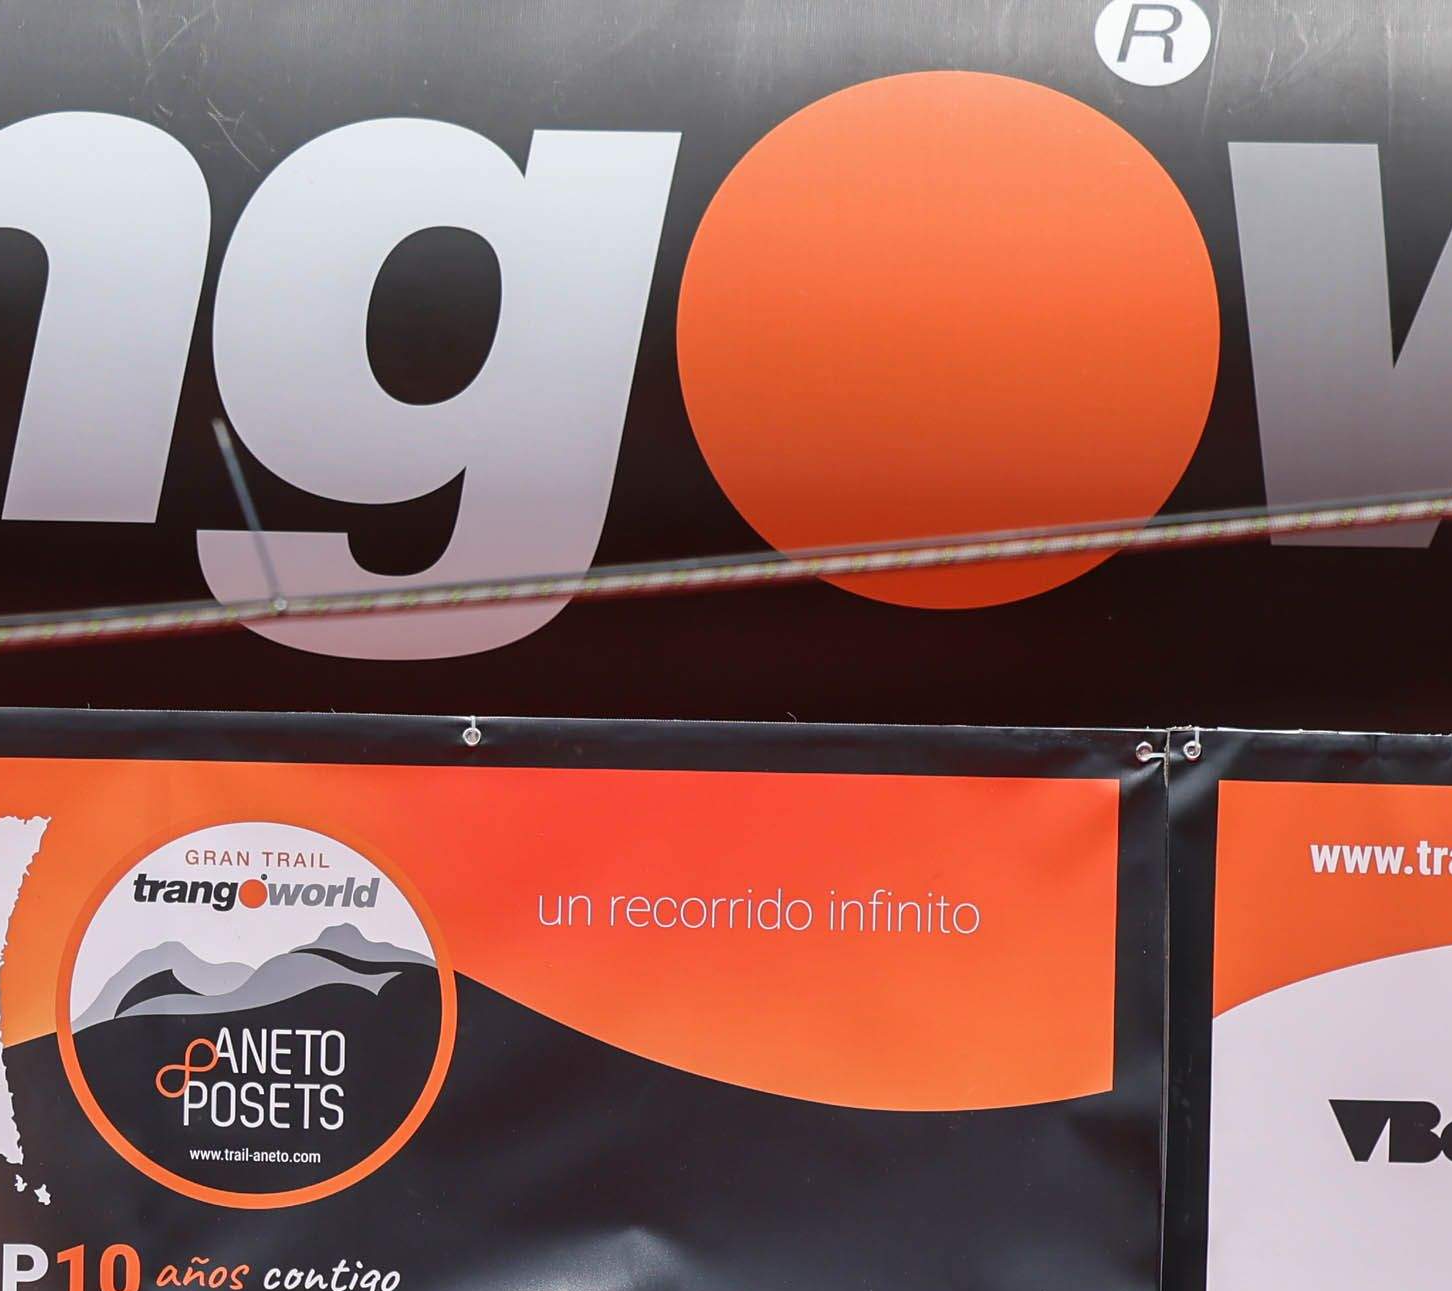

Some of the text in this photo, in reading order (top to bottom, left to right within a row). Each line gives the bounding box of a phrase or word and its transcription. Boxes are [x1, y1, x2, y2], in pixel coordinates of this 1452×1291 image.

[185, 849, 331, 870] GRAN TRAIL
[537, 887, 982, 935] un recorrido infinito
[214, 1026, 347, 1077] ANETO
[182, 1080, 346, 1131] POSETS
[188, 1146, 322, 1166] www.trail-aneto.com
[155, 1255, 251, 1291] años
